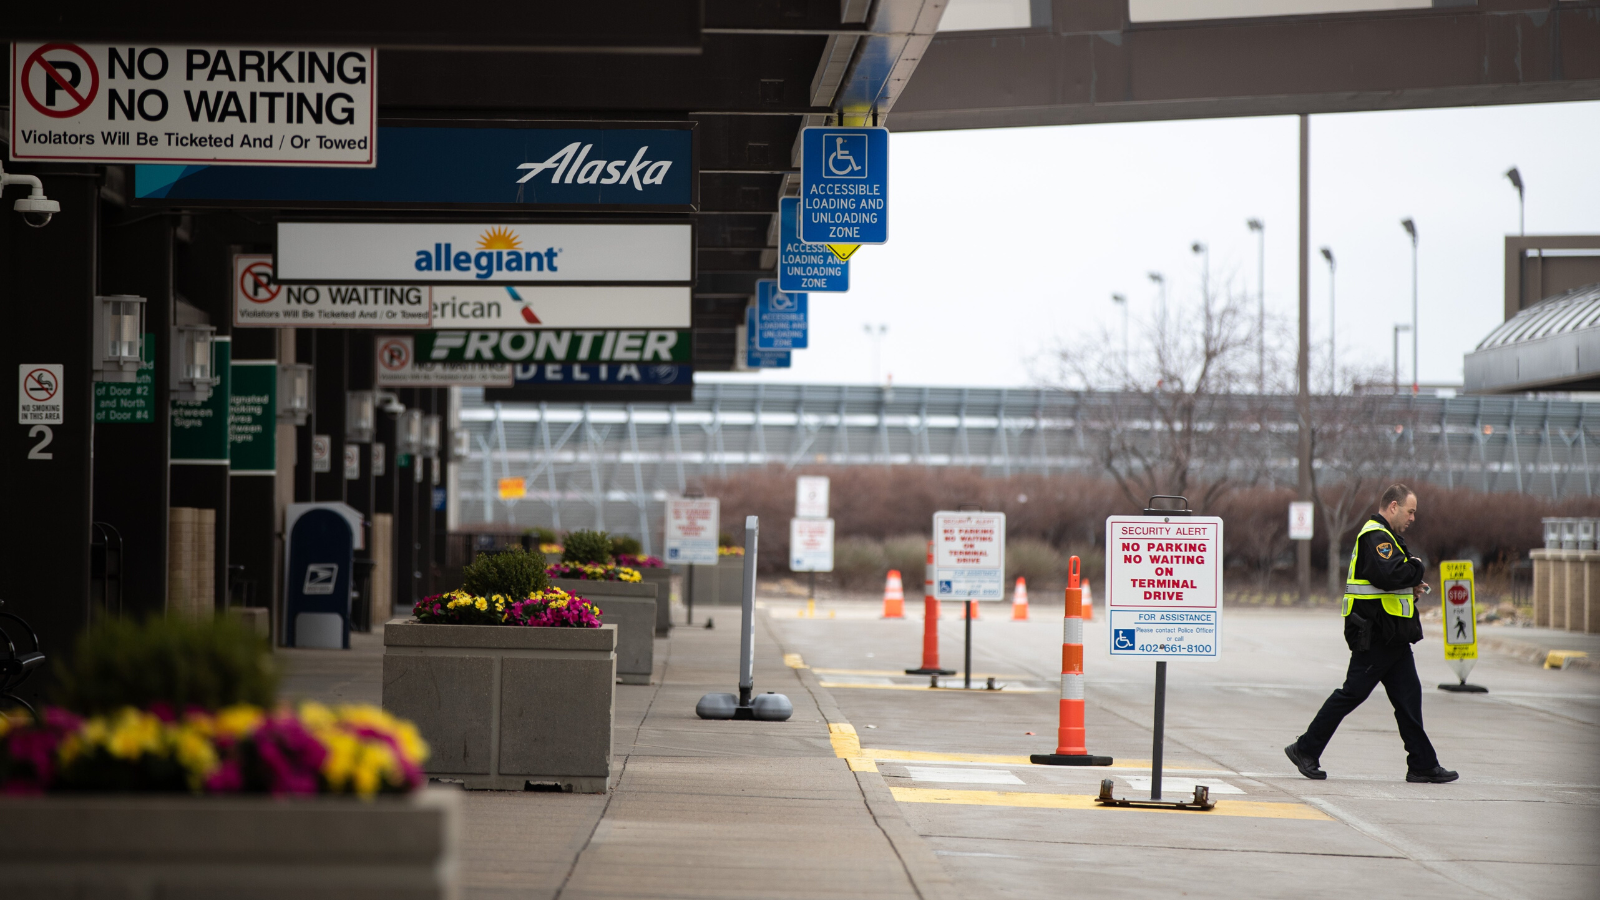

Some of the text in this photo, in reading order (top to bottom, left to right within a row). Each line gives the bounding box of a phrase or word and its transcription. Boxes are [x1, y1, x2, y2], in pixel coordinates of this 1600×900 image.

[108, 47, 367, 85] NO PARKING
[107, 88, 355, 125] NO WAITING
[21, 130, 95, 145] Violators
[101, 131, 130, 146] Will
[136, 132, 159, 147] Be
[164, 132, 234, 148] Ticketed
[239, 133, 273, 149] And
[290, 135, 311, 150] Or
[316, 135, 368, 150] Towed
[515, 141, 673, 191] Alaska
[810, 184, 880, 195] ACCESSIBLE
[806, 198, 884, 210] LOADING AND
[812, 212, 878, 224] UNLOADING
[829, 227, 860, 238] ZONE
[786, 243, 830, 253] ACCESSI
[414, 243, 558, 279] allegiant
[782, 255, 824, 265] LOADING
[787, 266, 842, 276] UNLOADING
[801, 278, 827, 288] ZONE
[287, 287, 422, 306] NO WAITING
[239, 309, 280, 319] Violators
[282, 309, 298, 319] Will
[302, 309, 315, 319] Be
[318, 309, 356, 319] Ticketed
[358, 310, 377, 319] And
[386, 310, 397, 319] Or
[430, 330, 679, 361] FRONTIER
[515, 363, 641, 381] DELTA
[96, 386, 149, 396] of Door #2
[100, 398, 145, 408] and North
[96, 410, 106, 420] of
[110, 410, 131, 420] Door
[27, 424, 53, 460] 2
[1121, 527, 1207, 536] SECURITY ALERT
[1122, 543, 1207, 553] NO PARKING
[1124, 555, 1205, 564] NO WAITING
[1155, 567, 1173, 576] ON
[1446, 564, 1467, 572] STATE
[1131, 579, 1197, 589] TERMINAL
[1144, 591, 1183, 601] DRIVE
[1448, 590, 1467, 601] STOP
